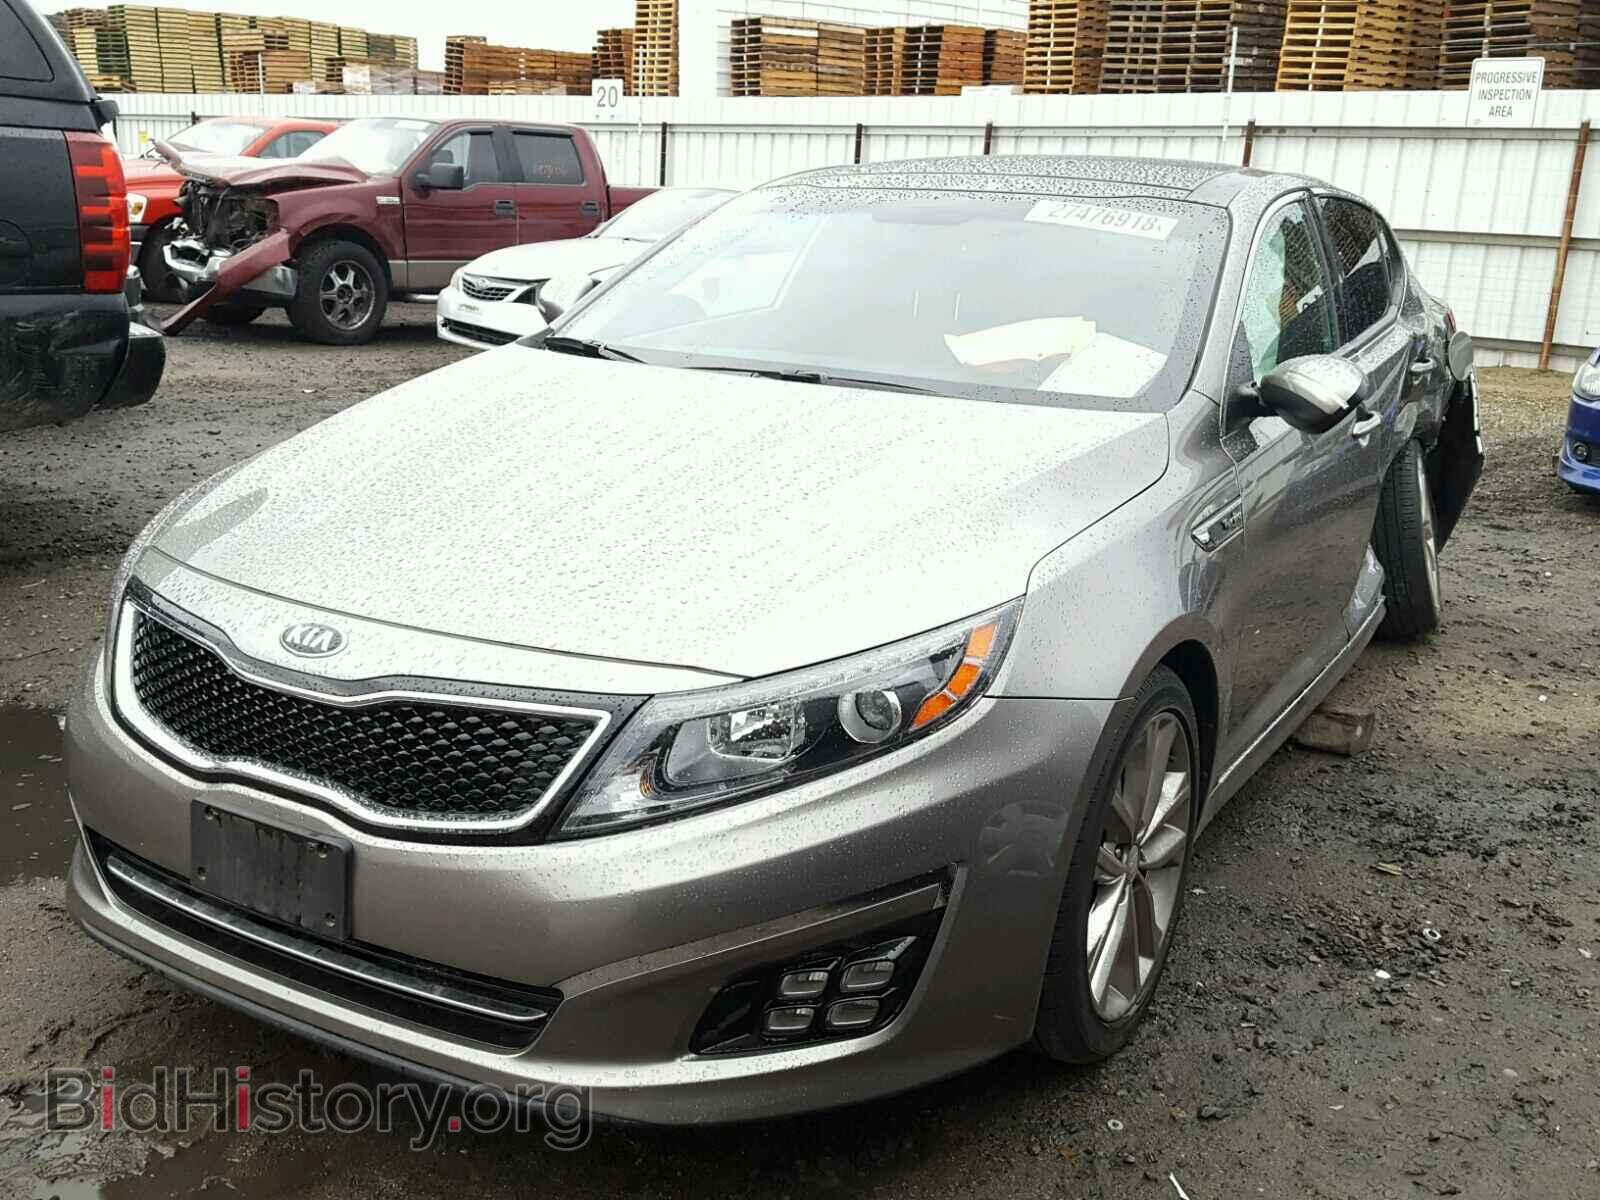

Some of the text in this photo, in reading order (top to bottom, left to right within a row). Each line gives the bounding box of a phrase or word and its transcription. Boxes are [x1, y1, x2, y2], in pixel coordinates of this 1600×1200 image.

[1475, 71, 1538, 84] PROGRESSIVE
[597, 85, 618, 108] 20
[1478, 88, 1533, 101] INSPECTION
[1488, 105, 1513, 118] AREA
[285, 624, 334, 652] KIA
